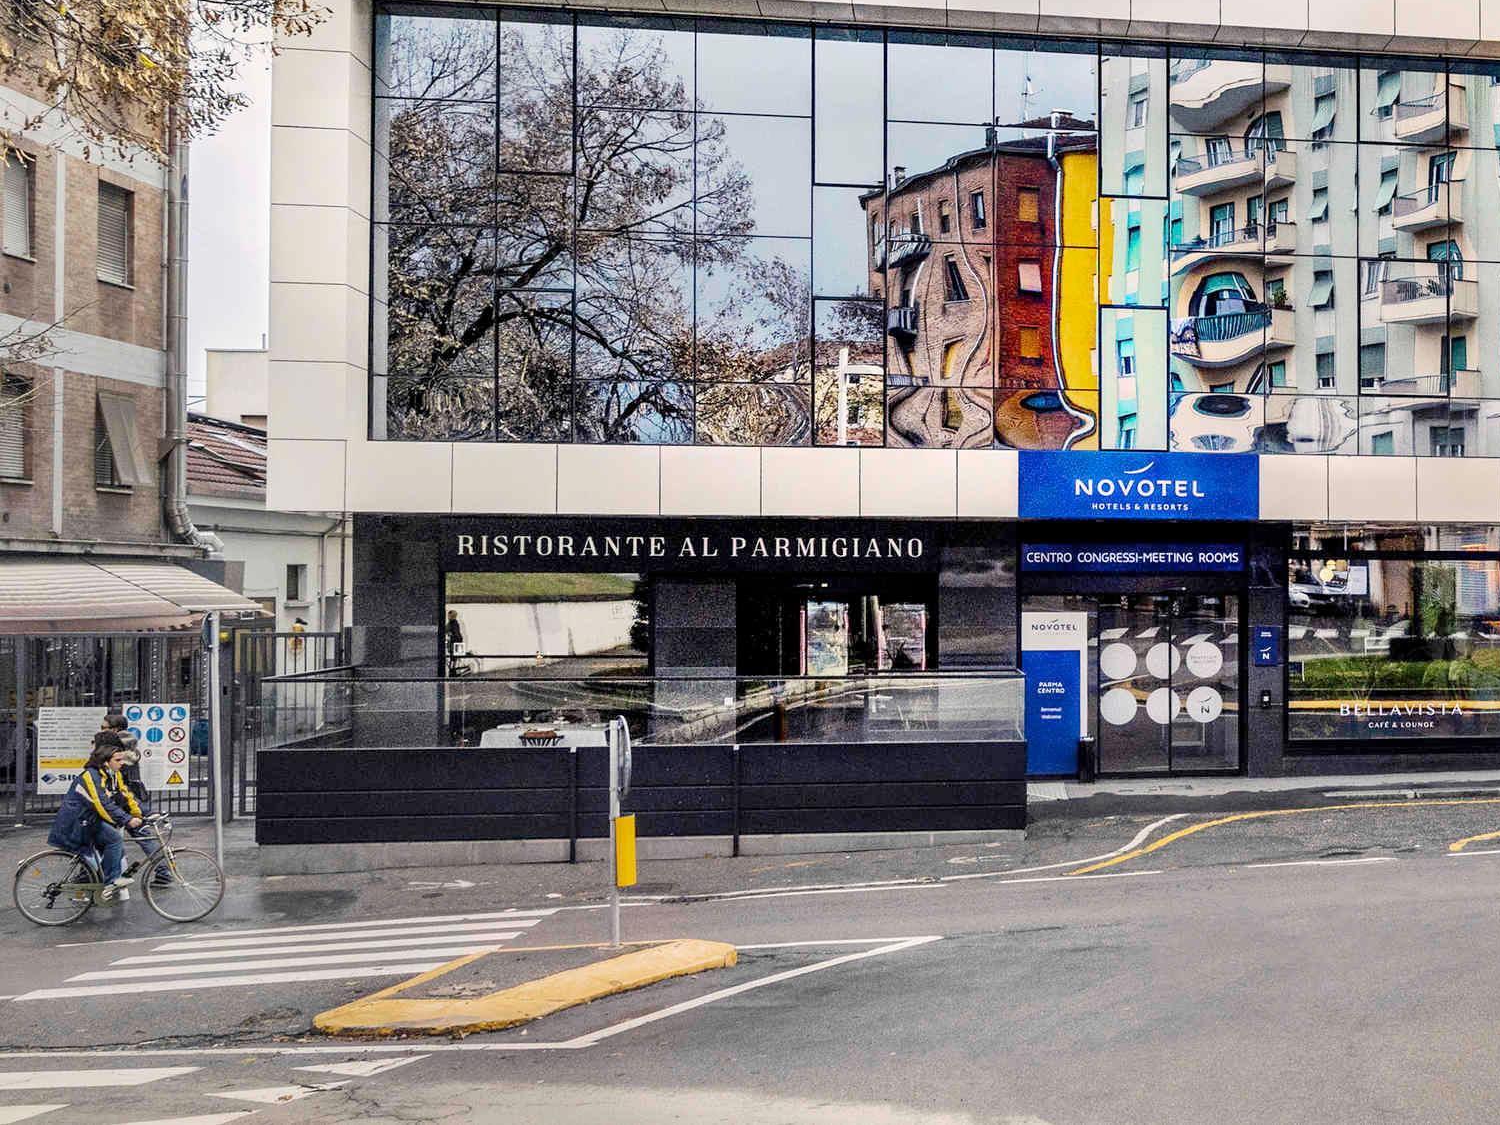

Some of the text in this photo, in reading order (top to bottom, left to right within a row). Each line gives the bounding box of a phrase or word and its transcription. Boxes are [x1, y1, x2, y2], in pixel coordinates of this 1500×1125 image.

[1074, 478, 1205, 498] NOVOTEL
[1091, 503, 1131, 511] HOTELS
[1144, 503, 1189, 512] RESORTS
[456, 534, 924, 559] RISTORANTE AL PARMIGIANO
[1026, 552, 1239, 564] CENTRO CONGRESSI-MEETING ROOMS
[1031, 623, 1078, 631] NOVOTEL
[1340, 702, 1463, 716] BELLAVISTA
[1368, 720, 1389, 729] CAFÉ
